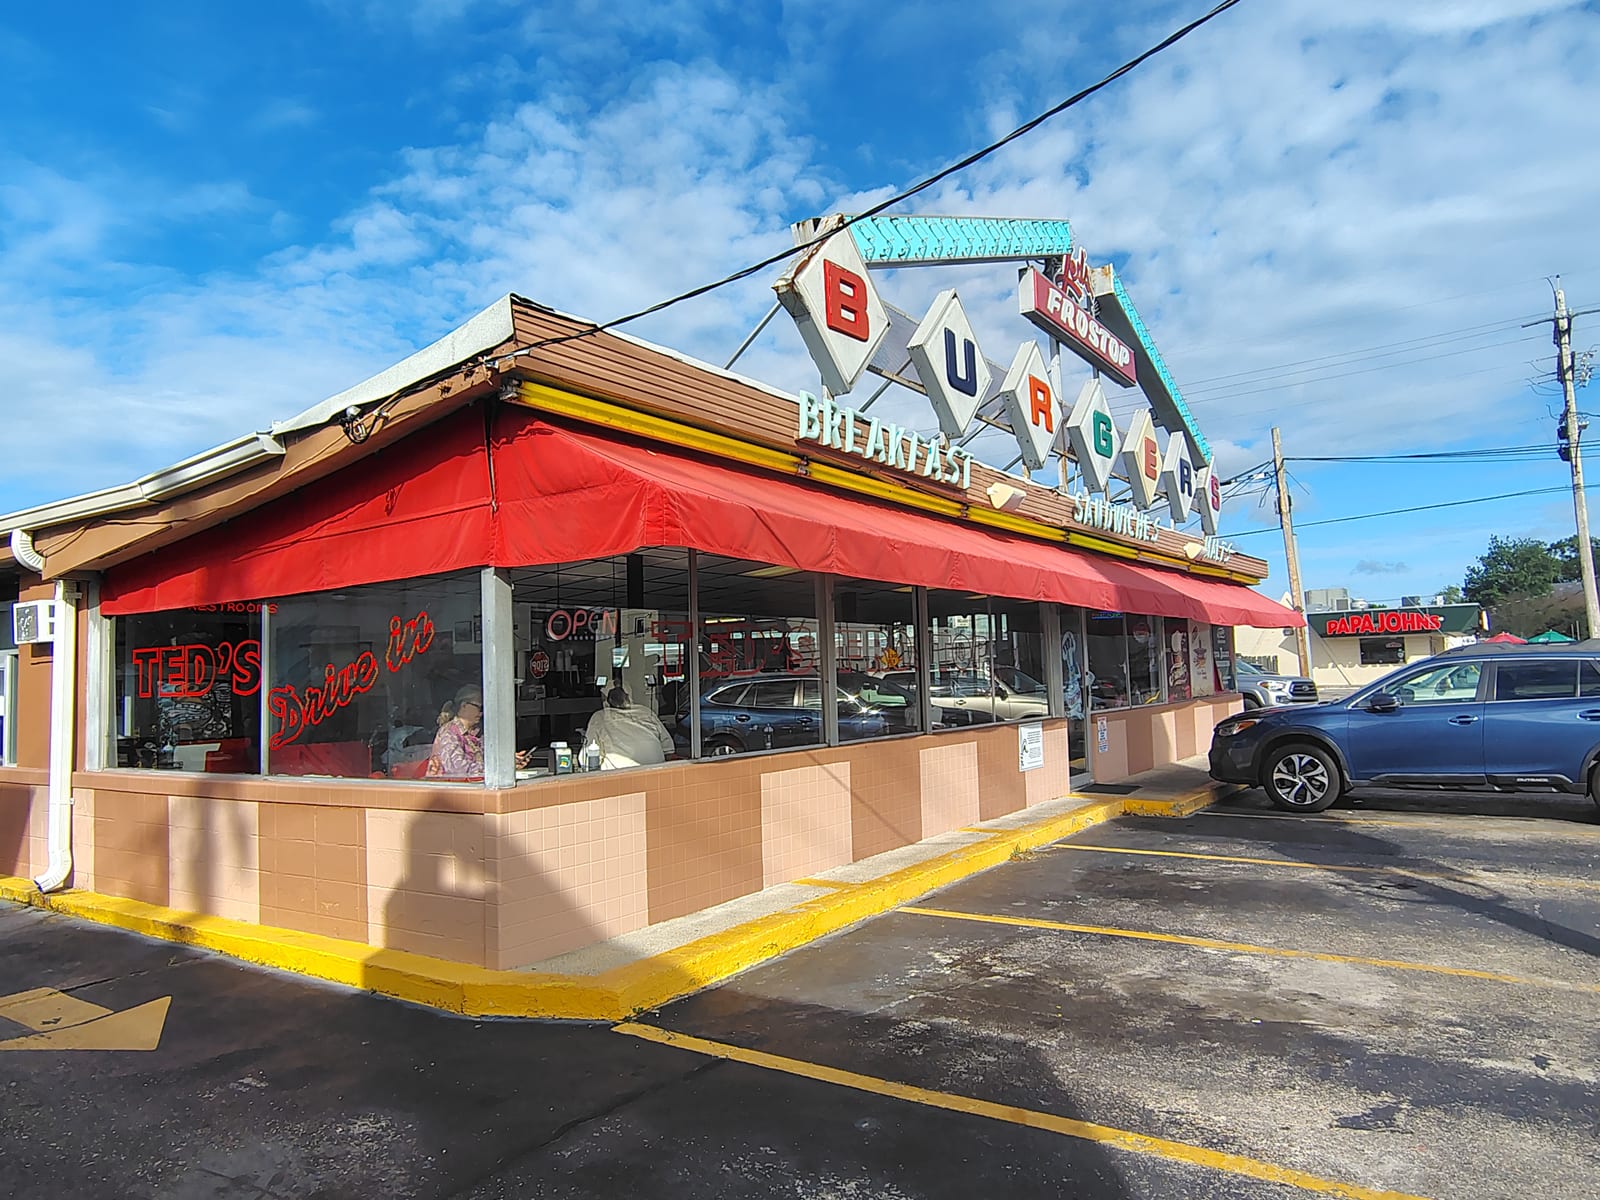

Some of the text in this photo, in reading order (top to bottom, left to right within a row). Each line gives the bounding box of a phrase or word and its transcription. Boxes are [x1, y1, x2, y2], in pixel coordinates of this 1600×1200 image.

[1046, 287, 1130, 368] FROSTOP
[799, 389, 975, 489] BREAKFAST
[1074, 491, 1161, 543] SANDWICHES
[546, 609, 619, 640] OPEN
[1327, 611, 1441, 635] PAPA JOHNS
[132, 640, 262, 698] TED'S
[267, 611, 435, 750] Drive in
